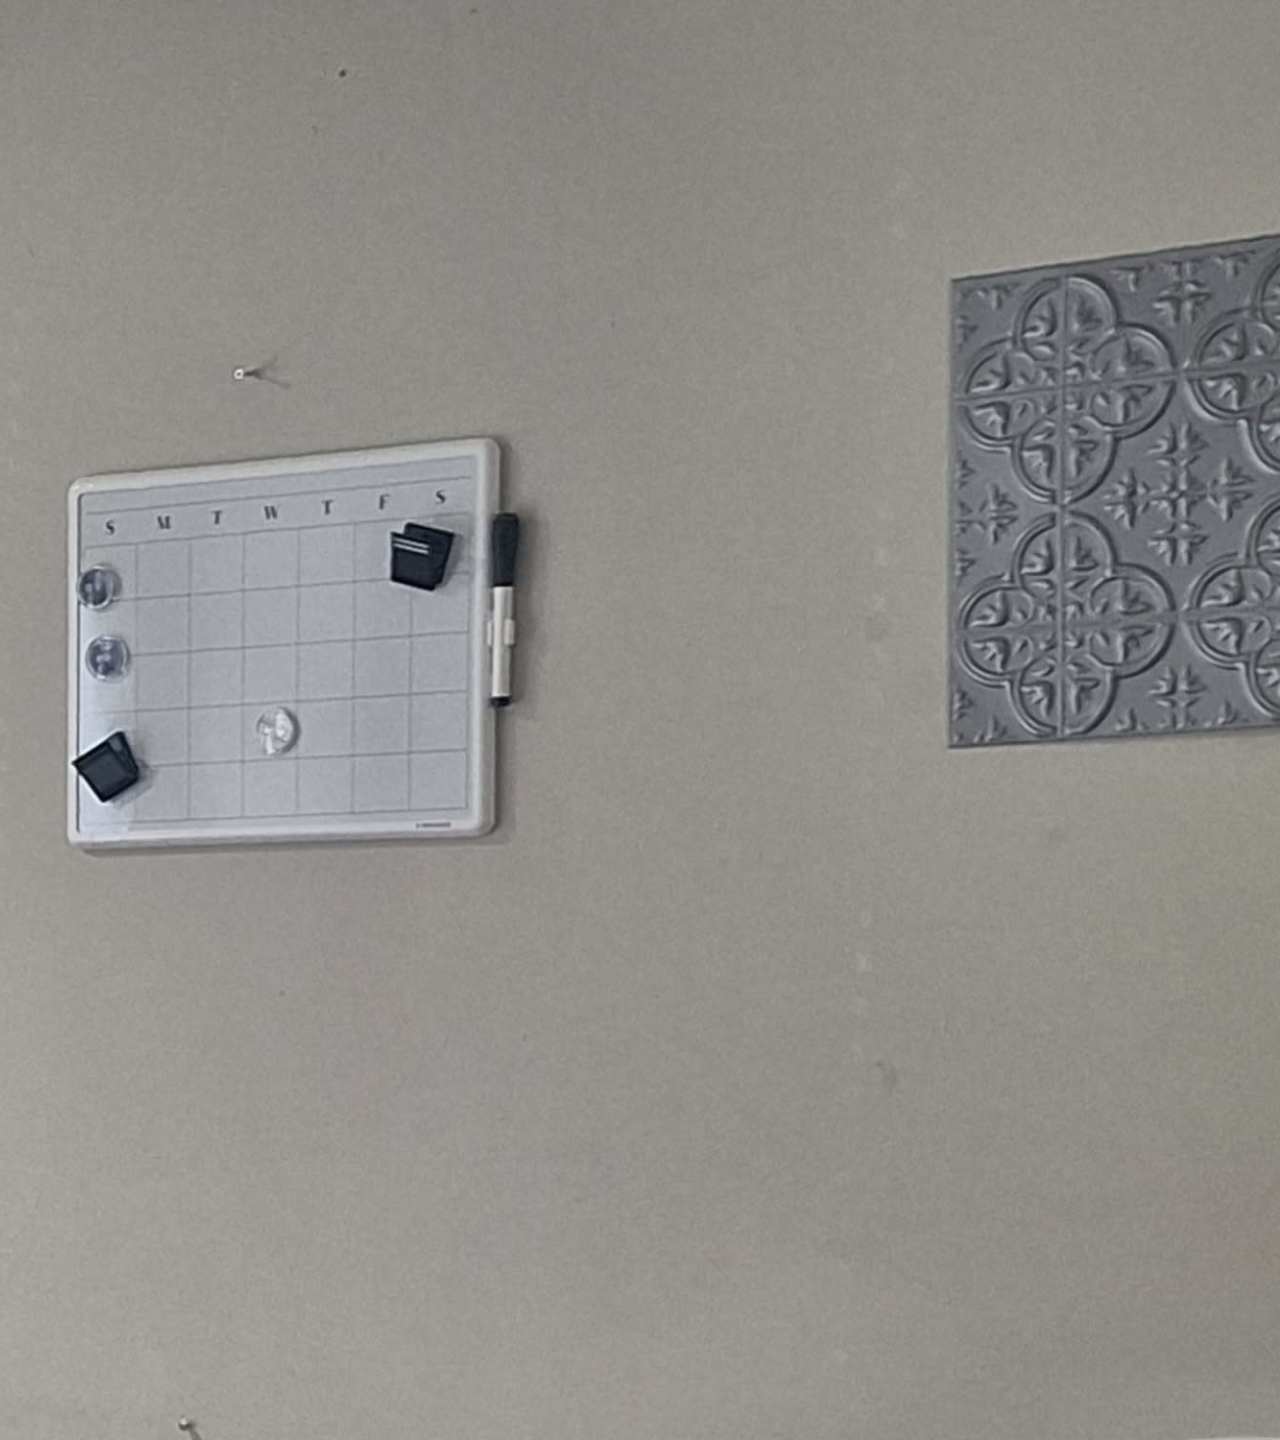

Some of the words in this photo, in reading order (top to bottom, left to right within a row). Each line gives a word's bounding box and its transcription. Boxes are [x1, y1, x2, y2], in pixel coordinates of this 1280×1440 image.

[106, 521, 115, 534] S
[157, 515, 171, 530] M
[213, 510, 222, 525] T
[263, 505, 278, 520] W
[322, 499, 333, 515] T
[379, 494, 389, 510] F
[436, 490, 446, 504] S
